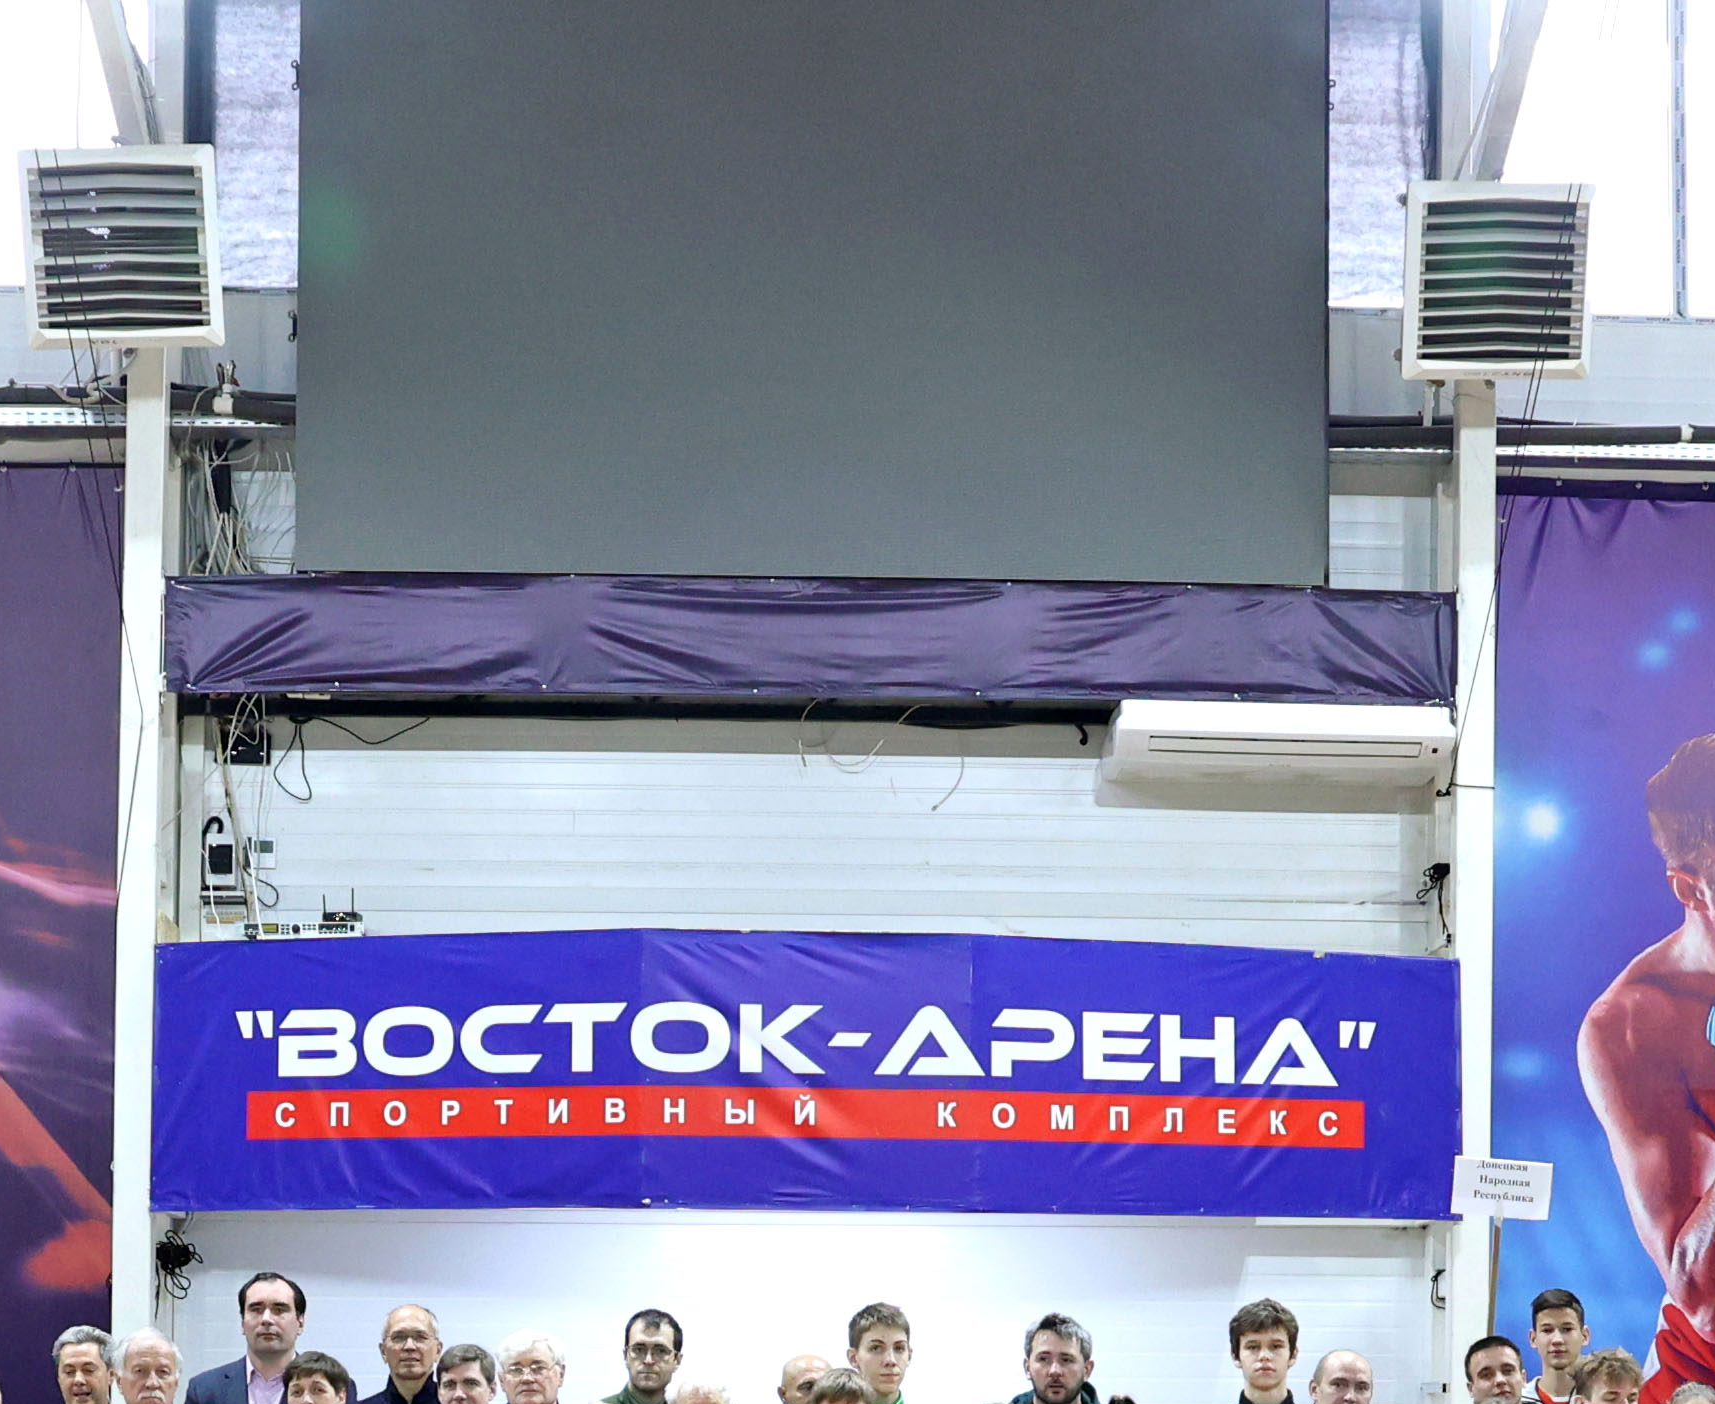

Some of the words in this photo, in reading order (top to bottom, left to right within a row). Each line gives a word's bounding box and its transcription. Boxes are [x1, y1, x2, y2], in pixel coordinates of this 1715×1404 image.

[234, 1001, 1377, 1087] "ВОСТОК-АРЕНА"
[274, 1094, 817, 1127] СПОРТИВНЫЙ
[936, 1101, 1339, 1137] КОМПЛЕКС
[1477, 1159, 1528, 1172] Донецкая
[1479, 1174, 1531, 1187] Народная
[1474, 1189, 1534, 1203] Республика
